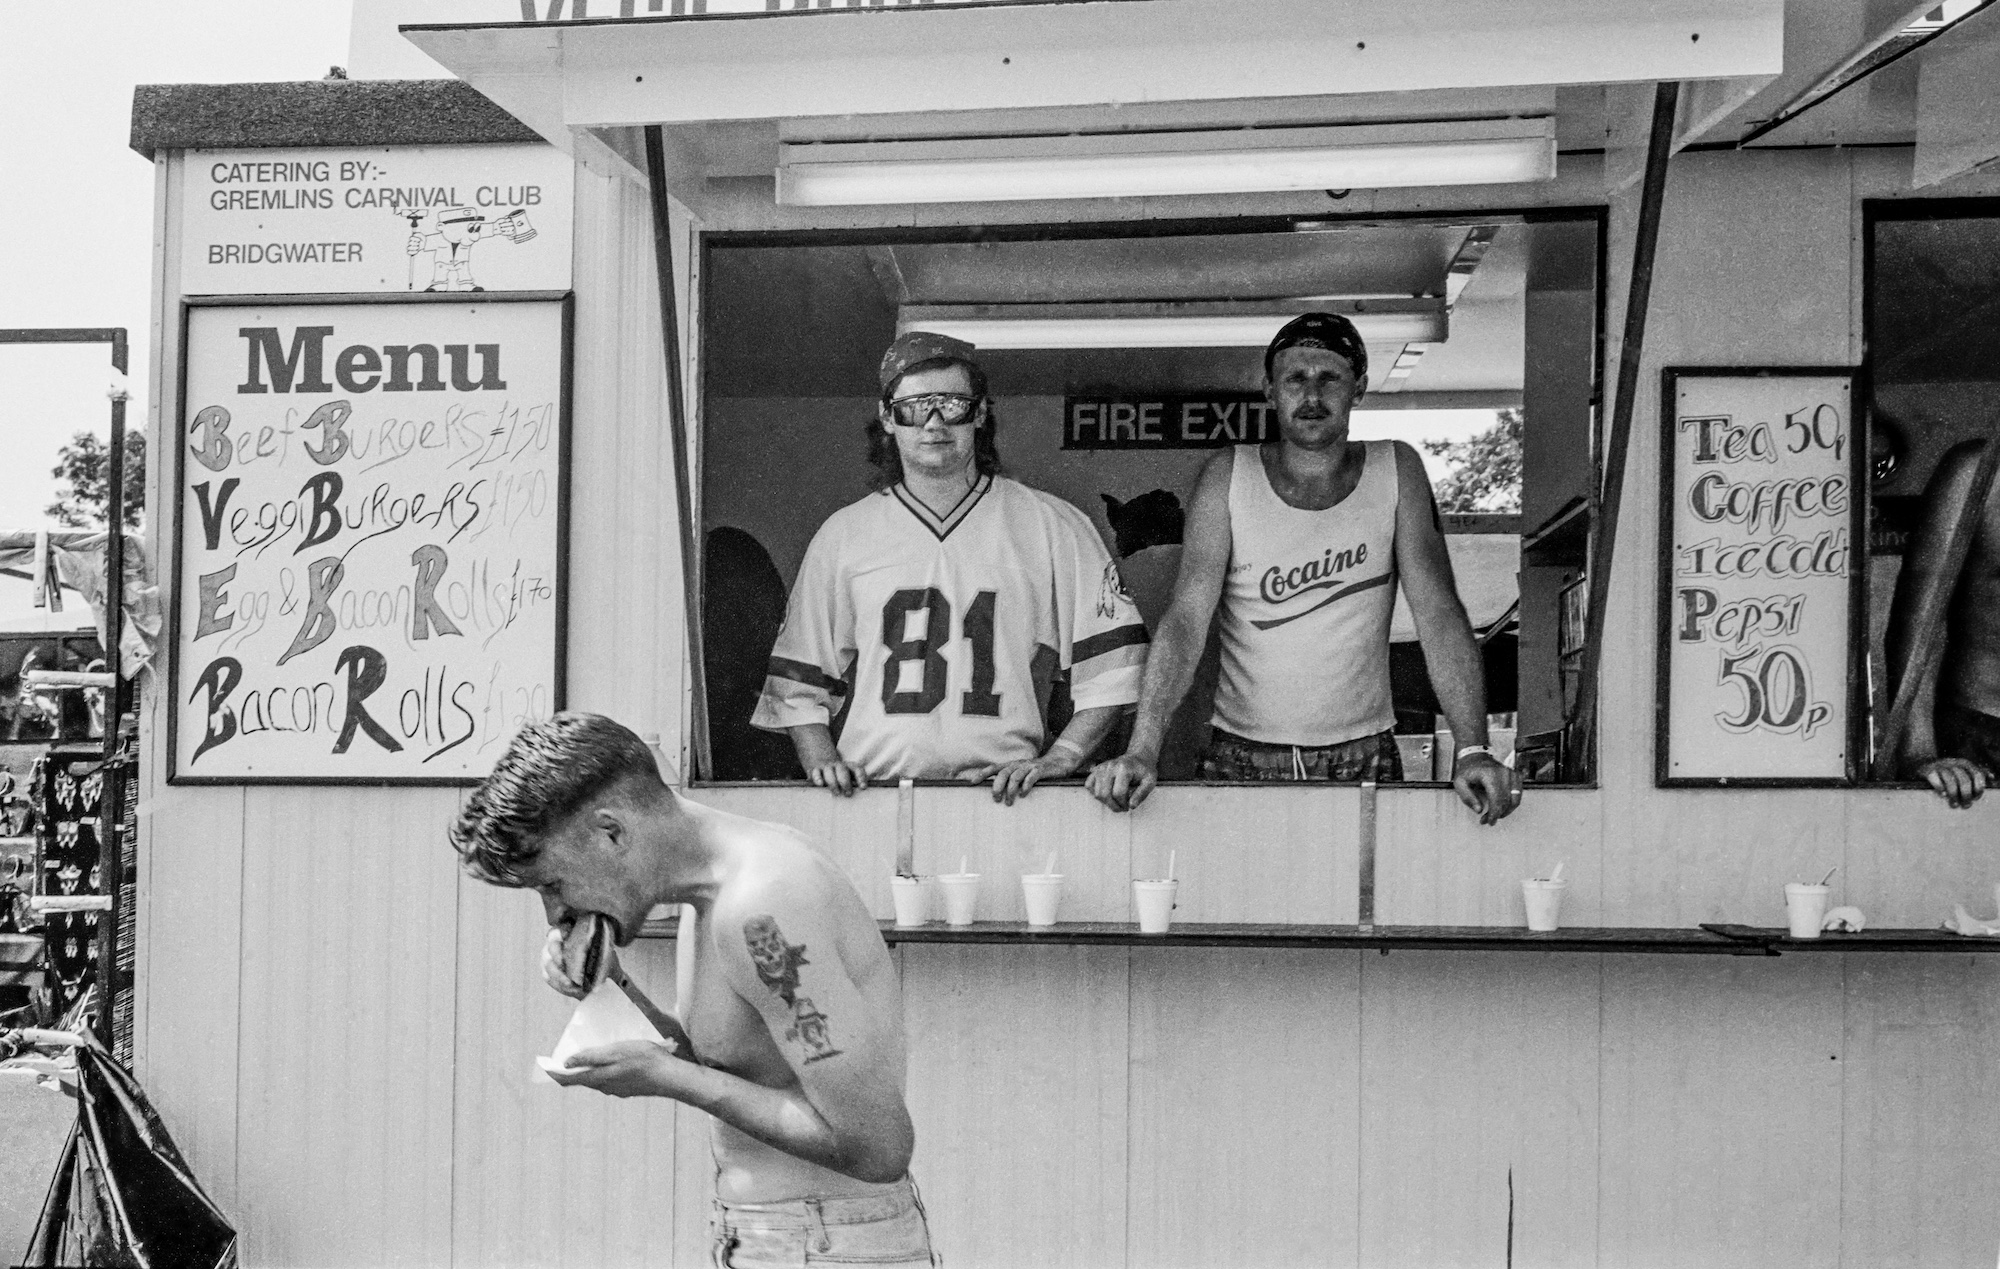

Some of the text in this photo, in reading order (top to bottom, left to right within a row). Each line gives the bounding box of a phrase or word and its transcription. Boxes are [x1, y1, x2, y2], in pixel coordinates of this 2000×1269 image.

[210, 161, 387, 184] CATERING BY:-
[210, 185, 542, 211] GREMLINS CARNIVAL CLUB
[208, 242, 363, 265] BRIDGWATER
[237, 325, 507, 394] Menu
[190, 405, 298, 472] Beef
[1072, 402, 1277, 441] FIRE EXIT
[1678, 403, 1847, 465] Tea 50p
[1687, 470, 1849, 536] Coffee
[279, 567, 299, 616] &
[411, 544, 508, 652] Rolls
[1259, 542, 1369, 605] Cocaine
[193, 562, 270, 655] Egg
[276, 556, 417, 667] Bacon
[1676, 585, 1807, 650] Pepsi
[879, 585, 1003, 720] 81
[188, 656, 342, 767] Bacon
[331, 645, 475, 764] Rolls
[1713, 642, 1835, 742] 50p
